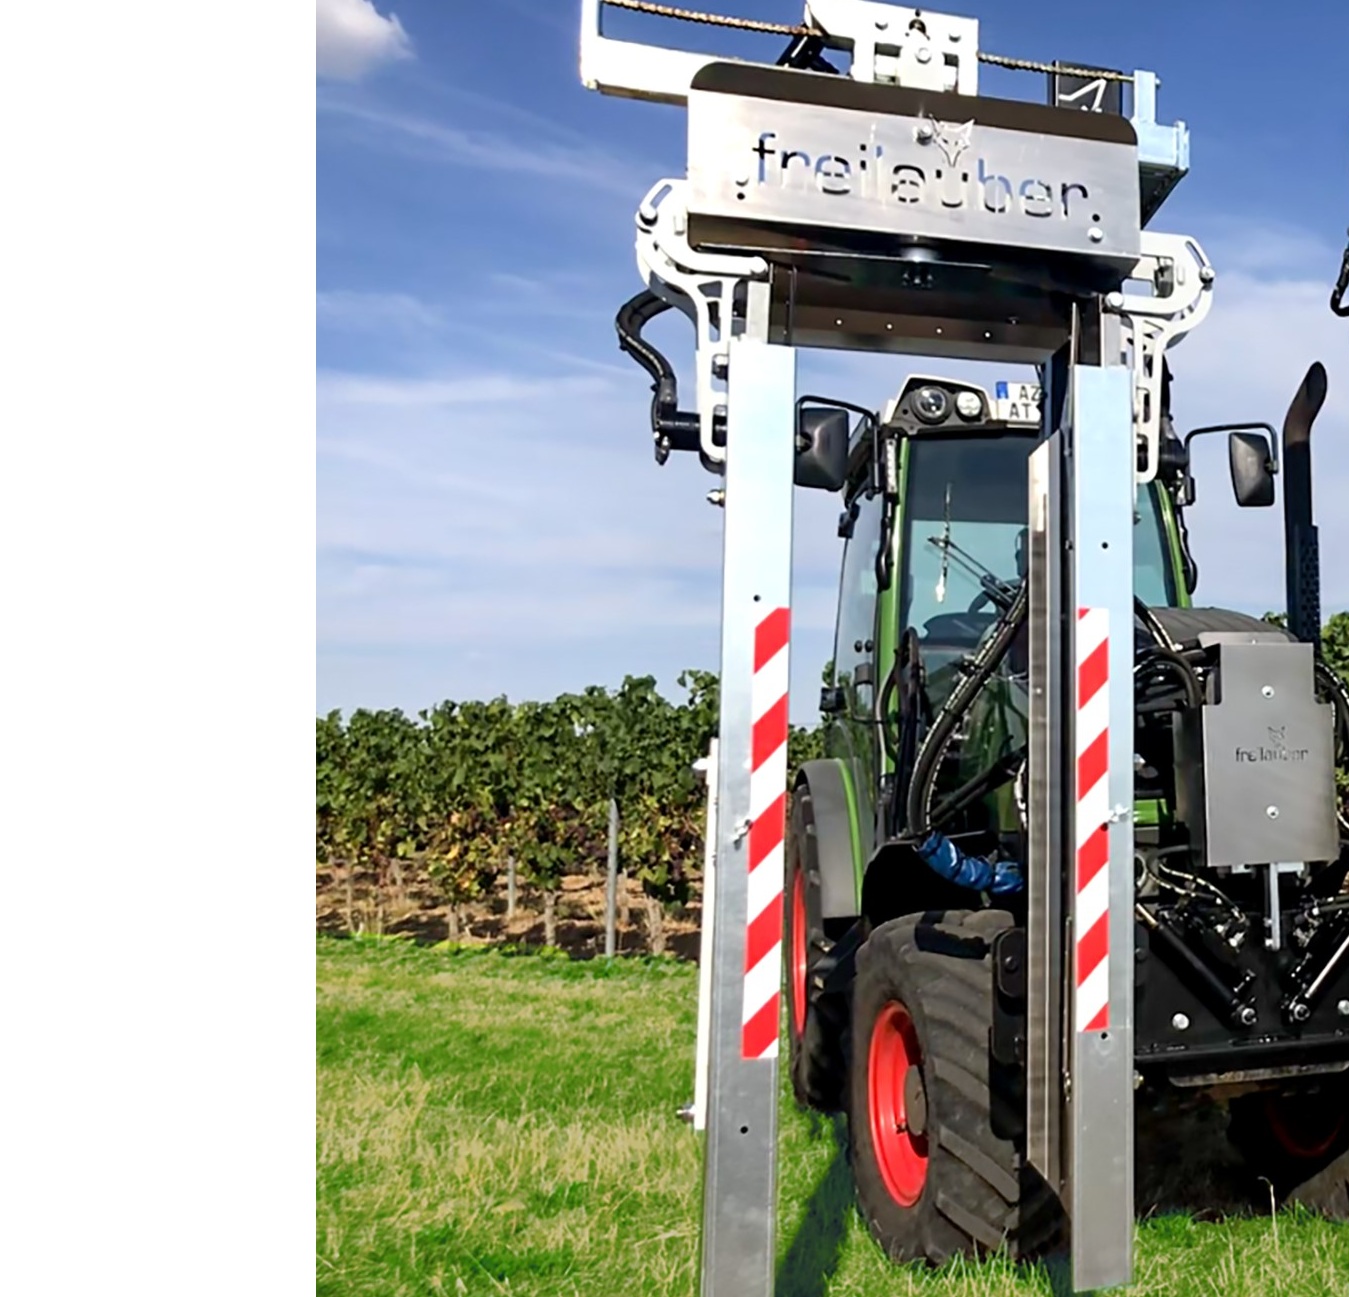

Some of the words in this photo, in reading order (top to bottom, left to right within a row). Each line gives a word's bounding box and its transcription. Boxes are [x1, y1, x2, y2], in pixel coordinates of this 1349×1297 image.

[752, 132, 1090, 218] freilauber
[1019, 385, 1041, 401] AZ
[1009, 402, 1032, 419] AT
